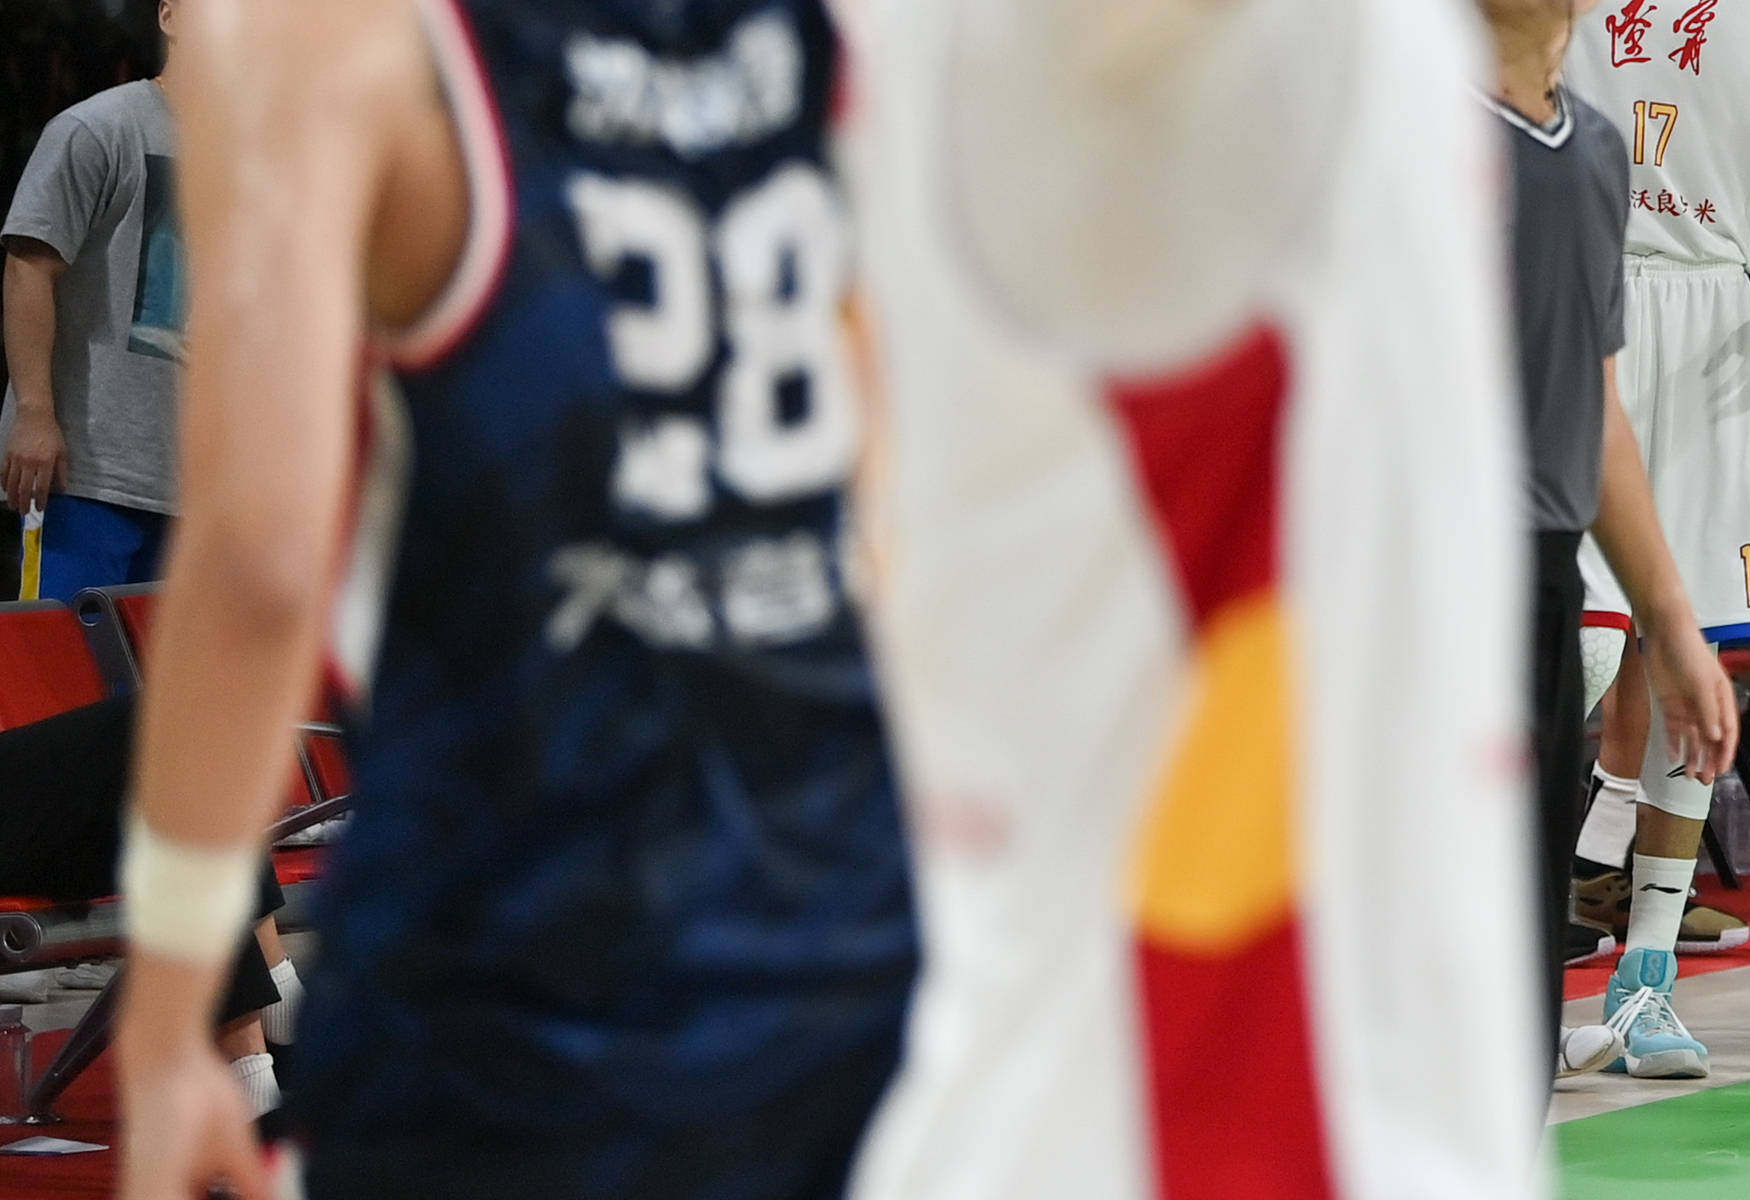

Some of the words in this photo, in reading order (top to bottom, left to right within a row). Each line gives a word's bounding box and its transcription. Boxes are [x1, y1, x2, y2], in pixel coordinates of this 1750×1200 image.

[1633, 100, 1678, 167] 17
[1630, 188, 1717, 225] 沃良米
